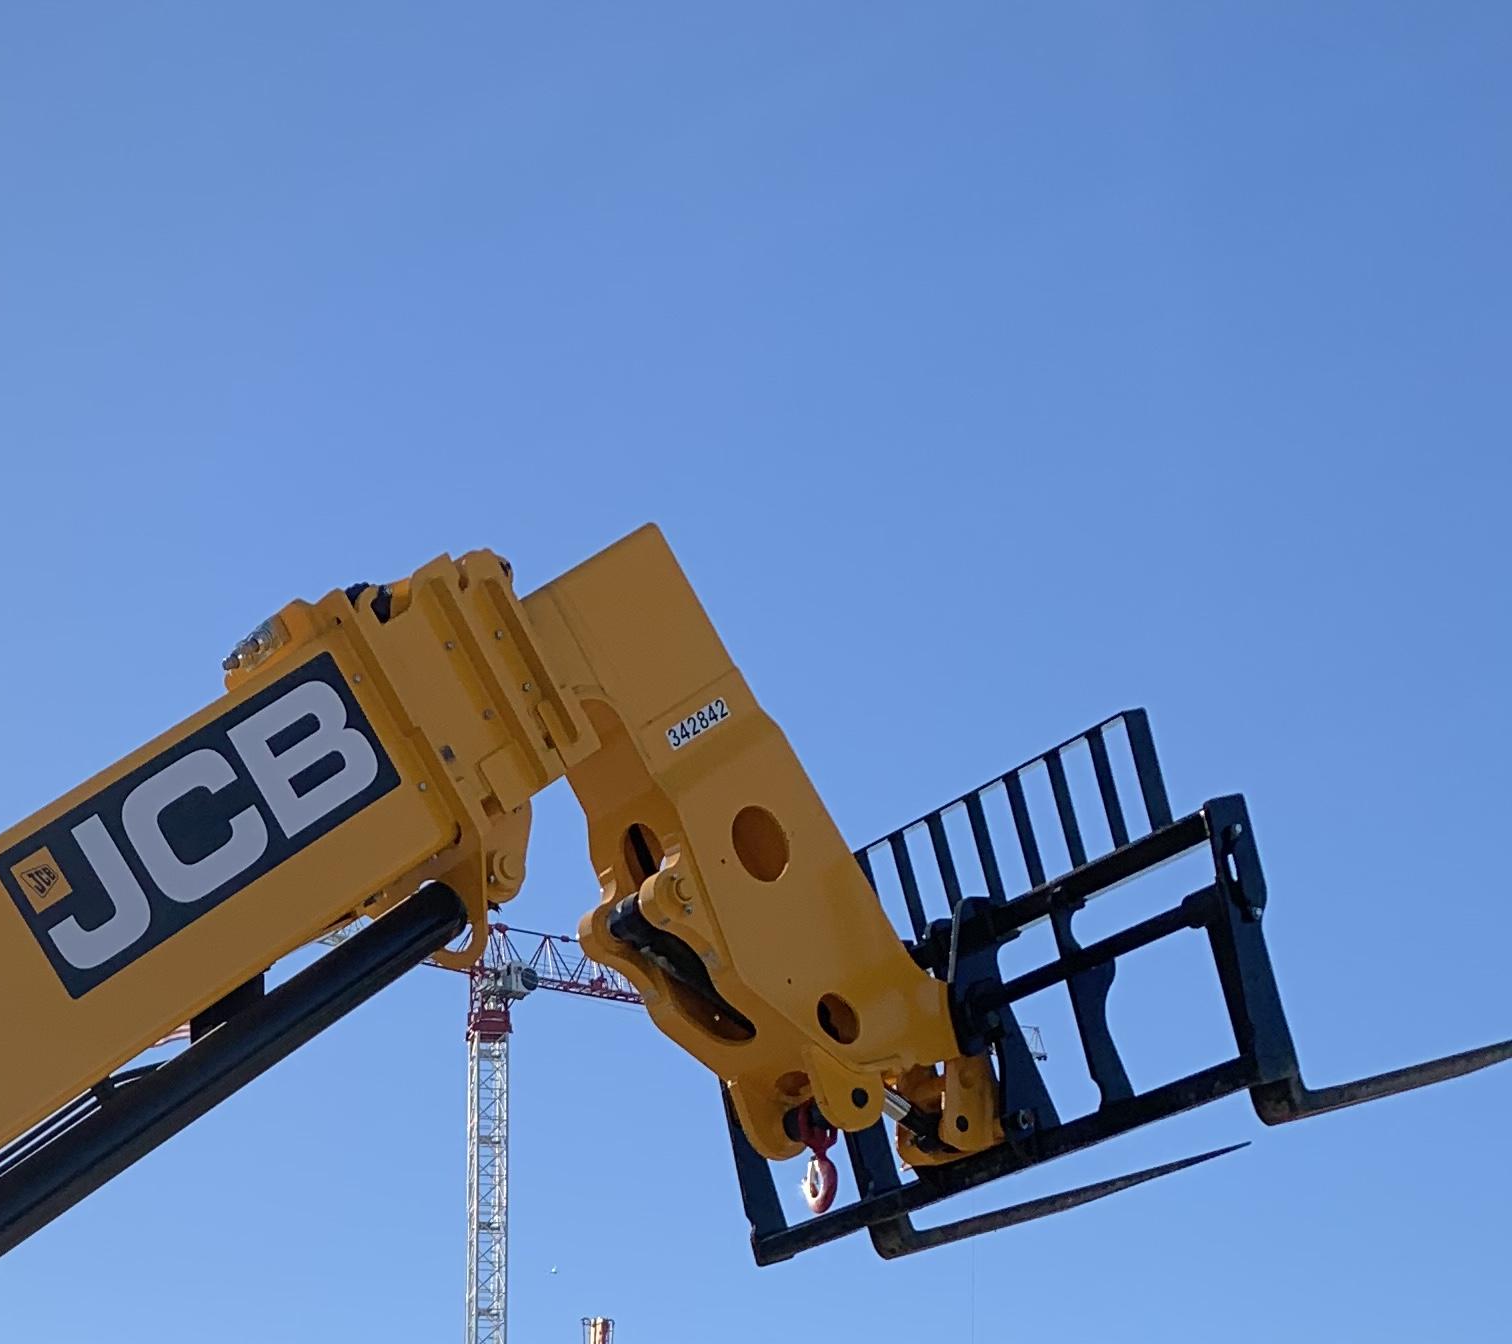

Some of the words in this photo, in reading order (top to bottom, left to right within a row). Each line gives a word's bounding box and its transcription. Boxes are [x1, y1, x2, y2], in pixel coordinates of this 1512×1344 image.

[668, 699, 729, 747] 342842
[47, 680, 379, 970] JCB
[27, 866, 56, 895] JCB
